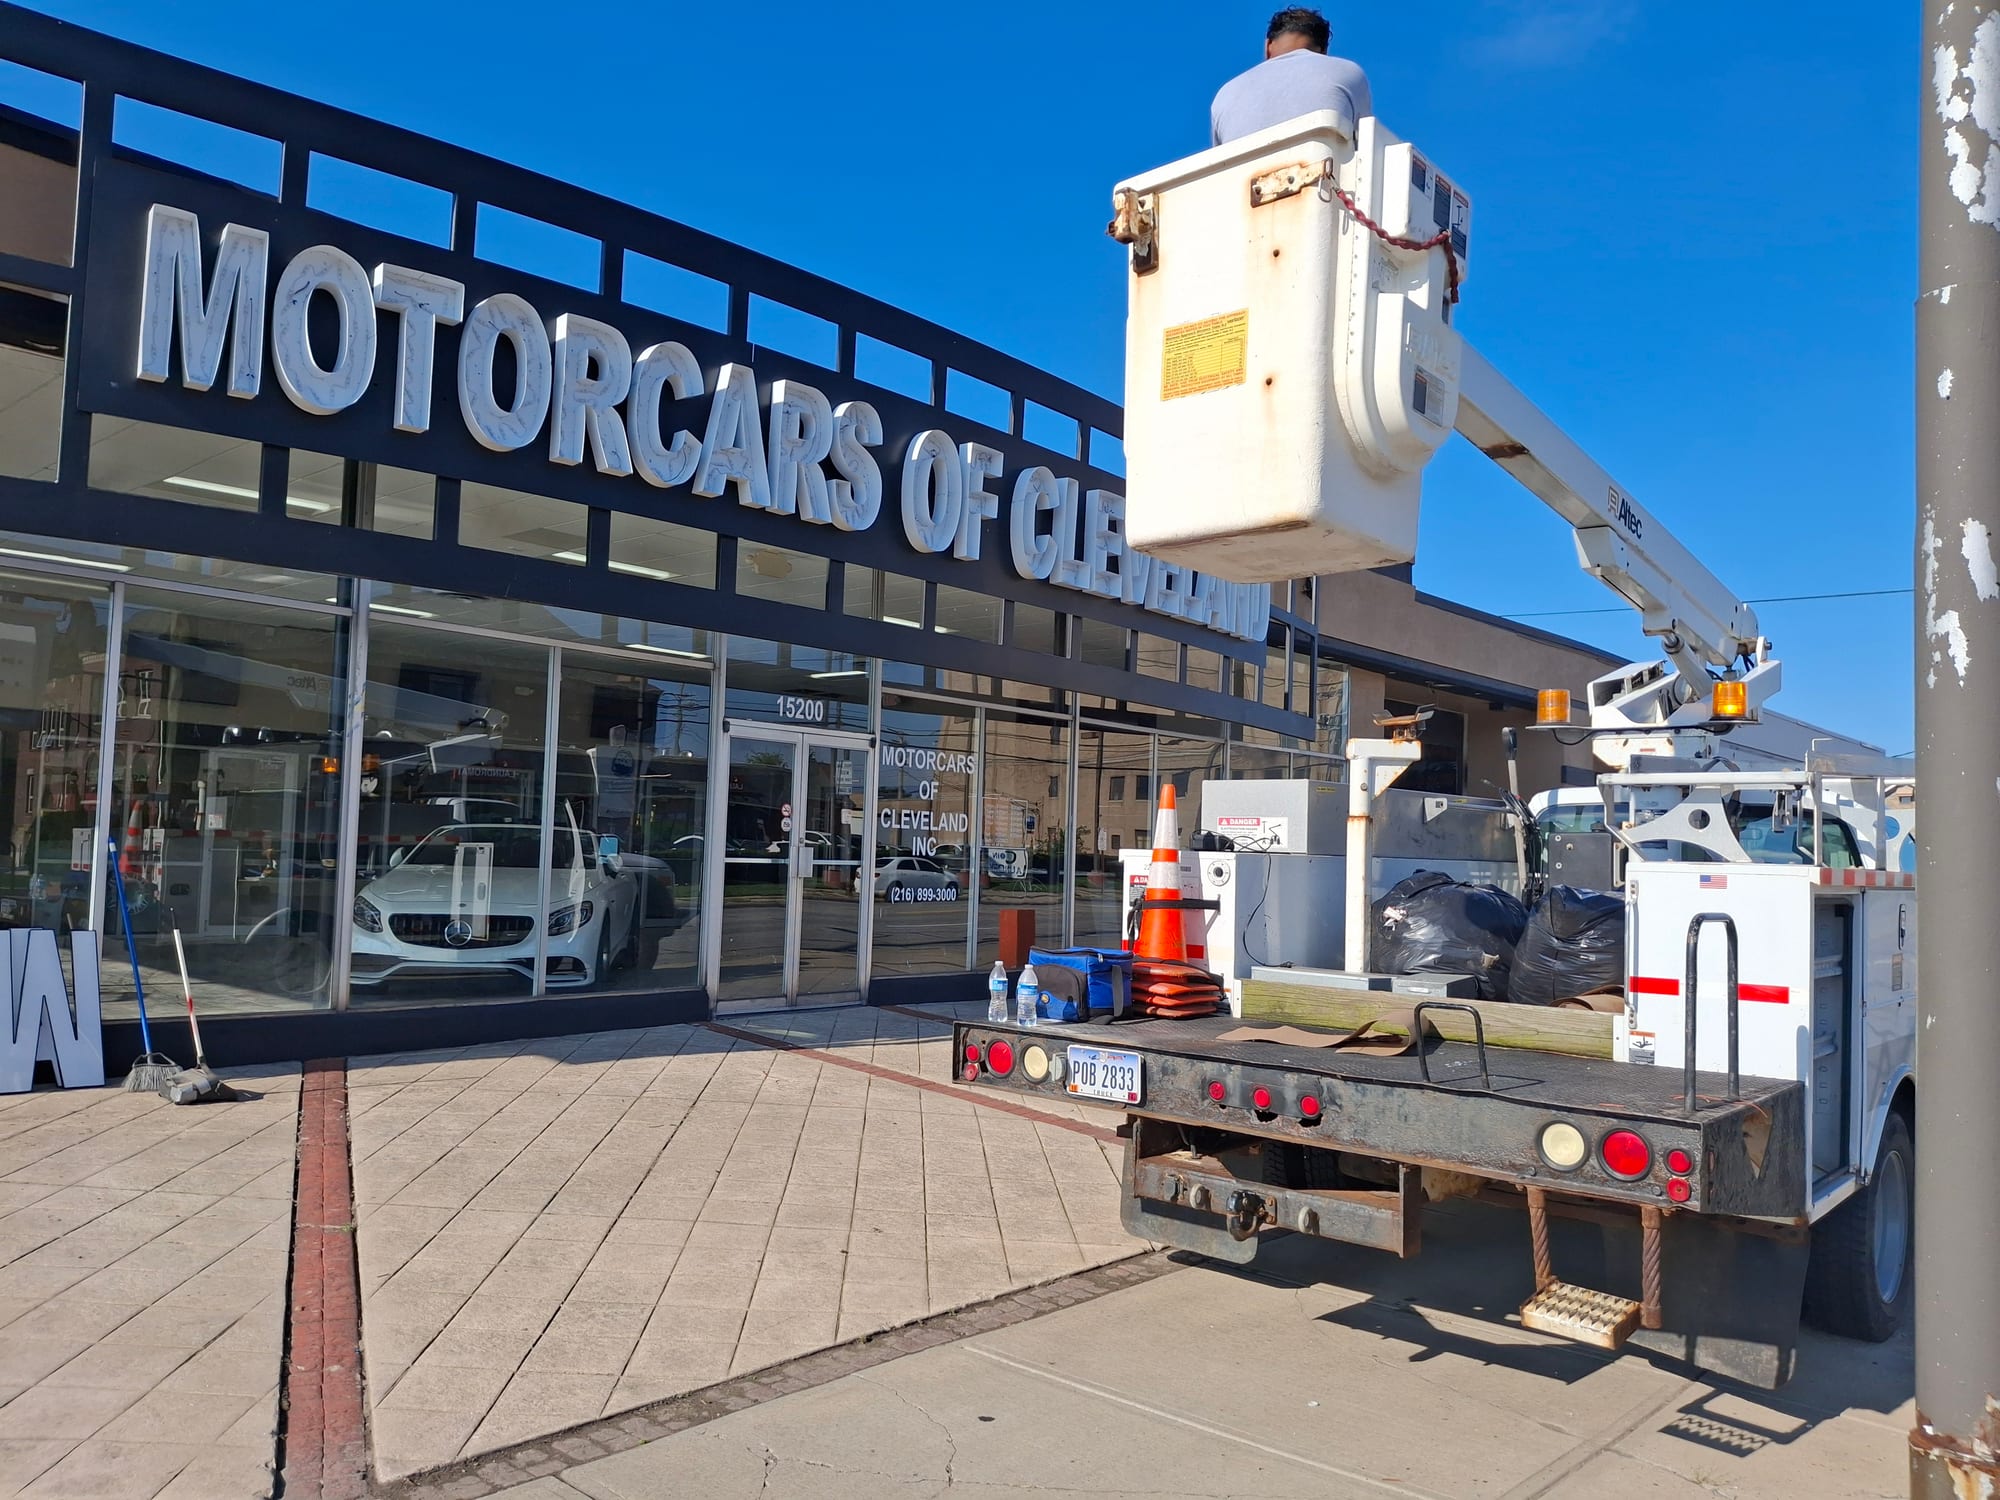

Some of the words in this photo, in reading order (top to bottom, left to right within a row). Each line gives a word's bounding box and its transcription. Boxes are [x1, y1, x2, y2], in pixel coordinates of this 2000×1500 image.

[135, 202, 884, 532] MOTORCARS
[901, 429, 1004, 561] OF
[1618, 496, 1643, 540] Altec
[776, 695, 824, 722] 15200
[882, 745, 976, 775] MOTORCARS
[919, 780, 940, 800] OF
[880, 807, 968, 833] CLEVELAND
[912, 836, 937, 857] INC
[891, 887, 914, 904] (216)
[917, 887, 957, 902] 899-3000
[1101, 1064, 1134, 1092] 2833
